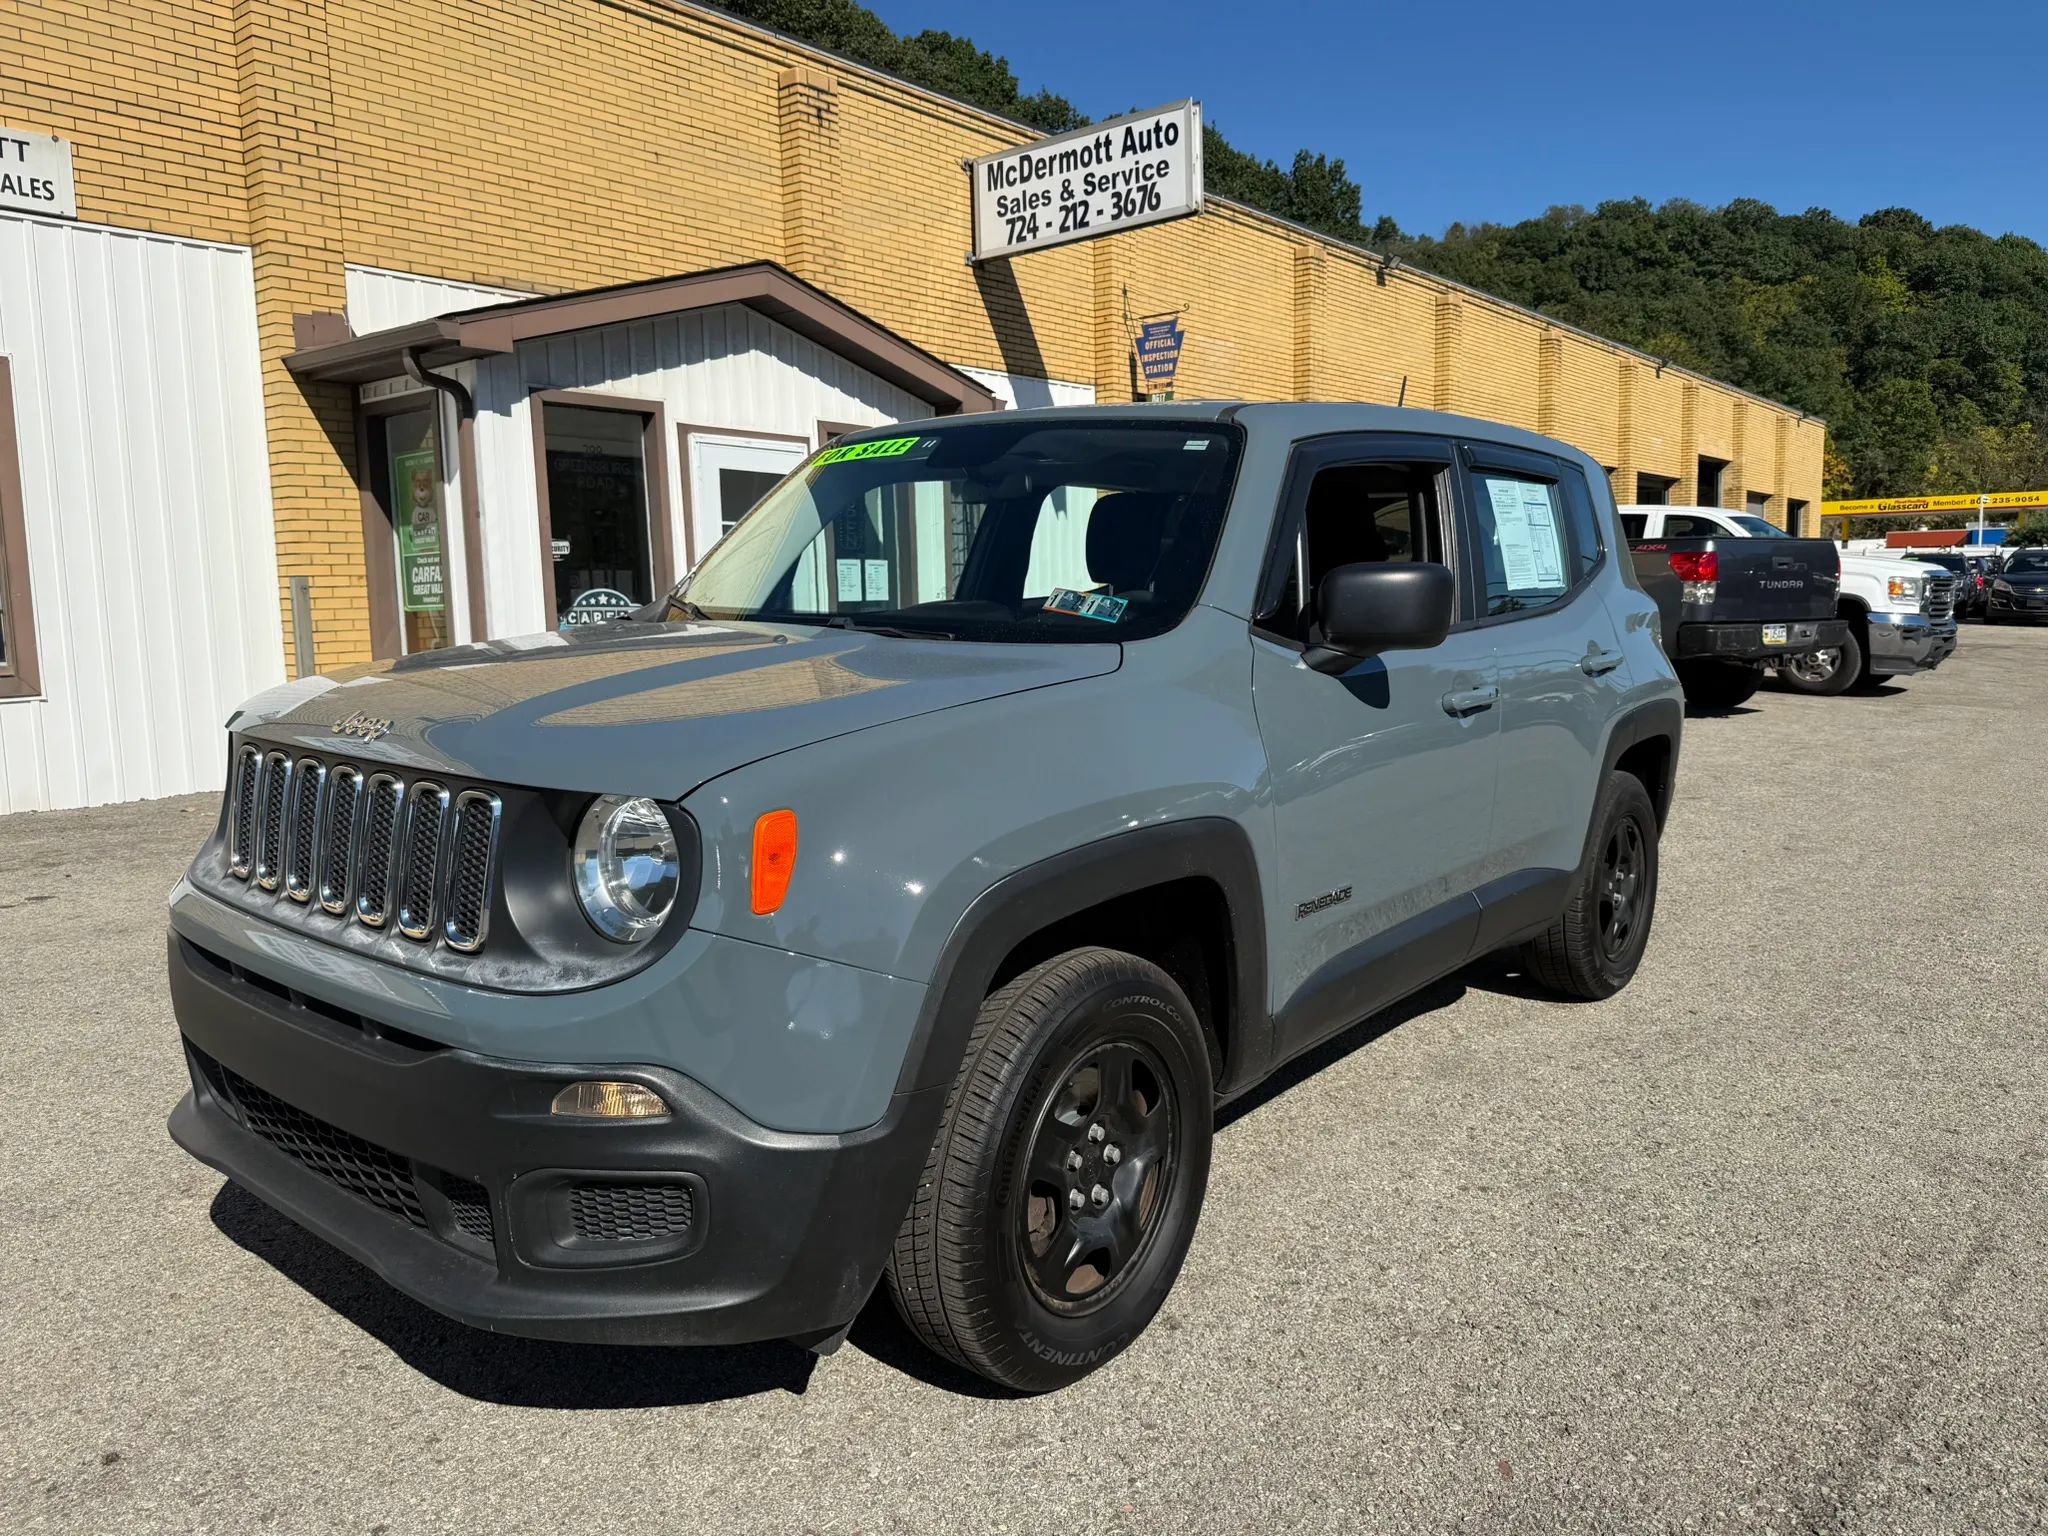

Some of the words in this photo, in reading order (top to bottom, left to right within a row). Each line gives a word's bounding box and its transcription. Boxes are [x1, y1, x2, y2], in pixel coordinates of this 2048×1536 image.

[987, 132, 1113, 192] McDermott
[1120, 119, 1179, 159] Auto
[996, 189, 1051, 218] Sales
[1060, 179, 1075, 202] &
[1083, 159, 1170, 197] Service
[1145, 338, 1175, 350] OFFICIAL
[1141, 350, 1178, 363] INSPECTION
[1145, 363, 1173, 374] STATION
[856, 439, 915, 457] SALE
[1877, 502, 1929, 511] Glasscard
[412, 566, 443, 584] CARFA
[1759, 580, 1804, 589] TUNDRA
[331, 710, 394, 744] Jeep
[1295, 886, 1352, 921] RENEGADE
